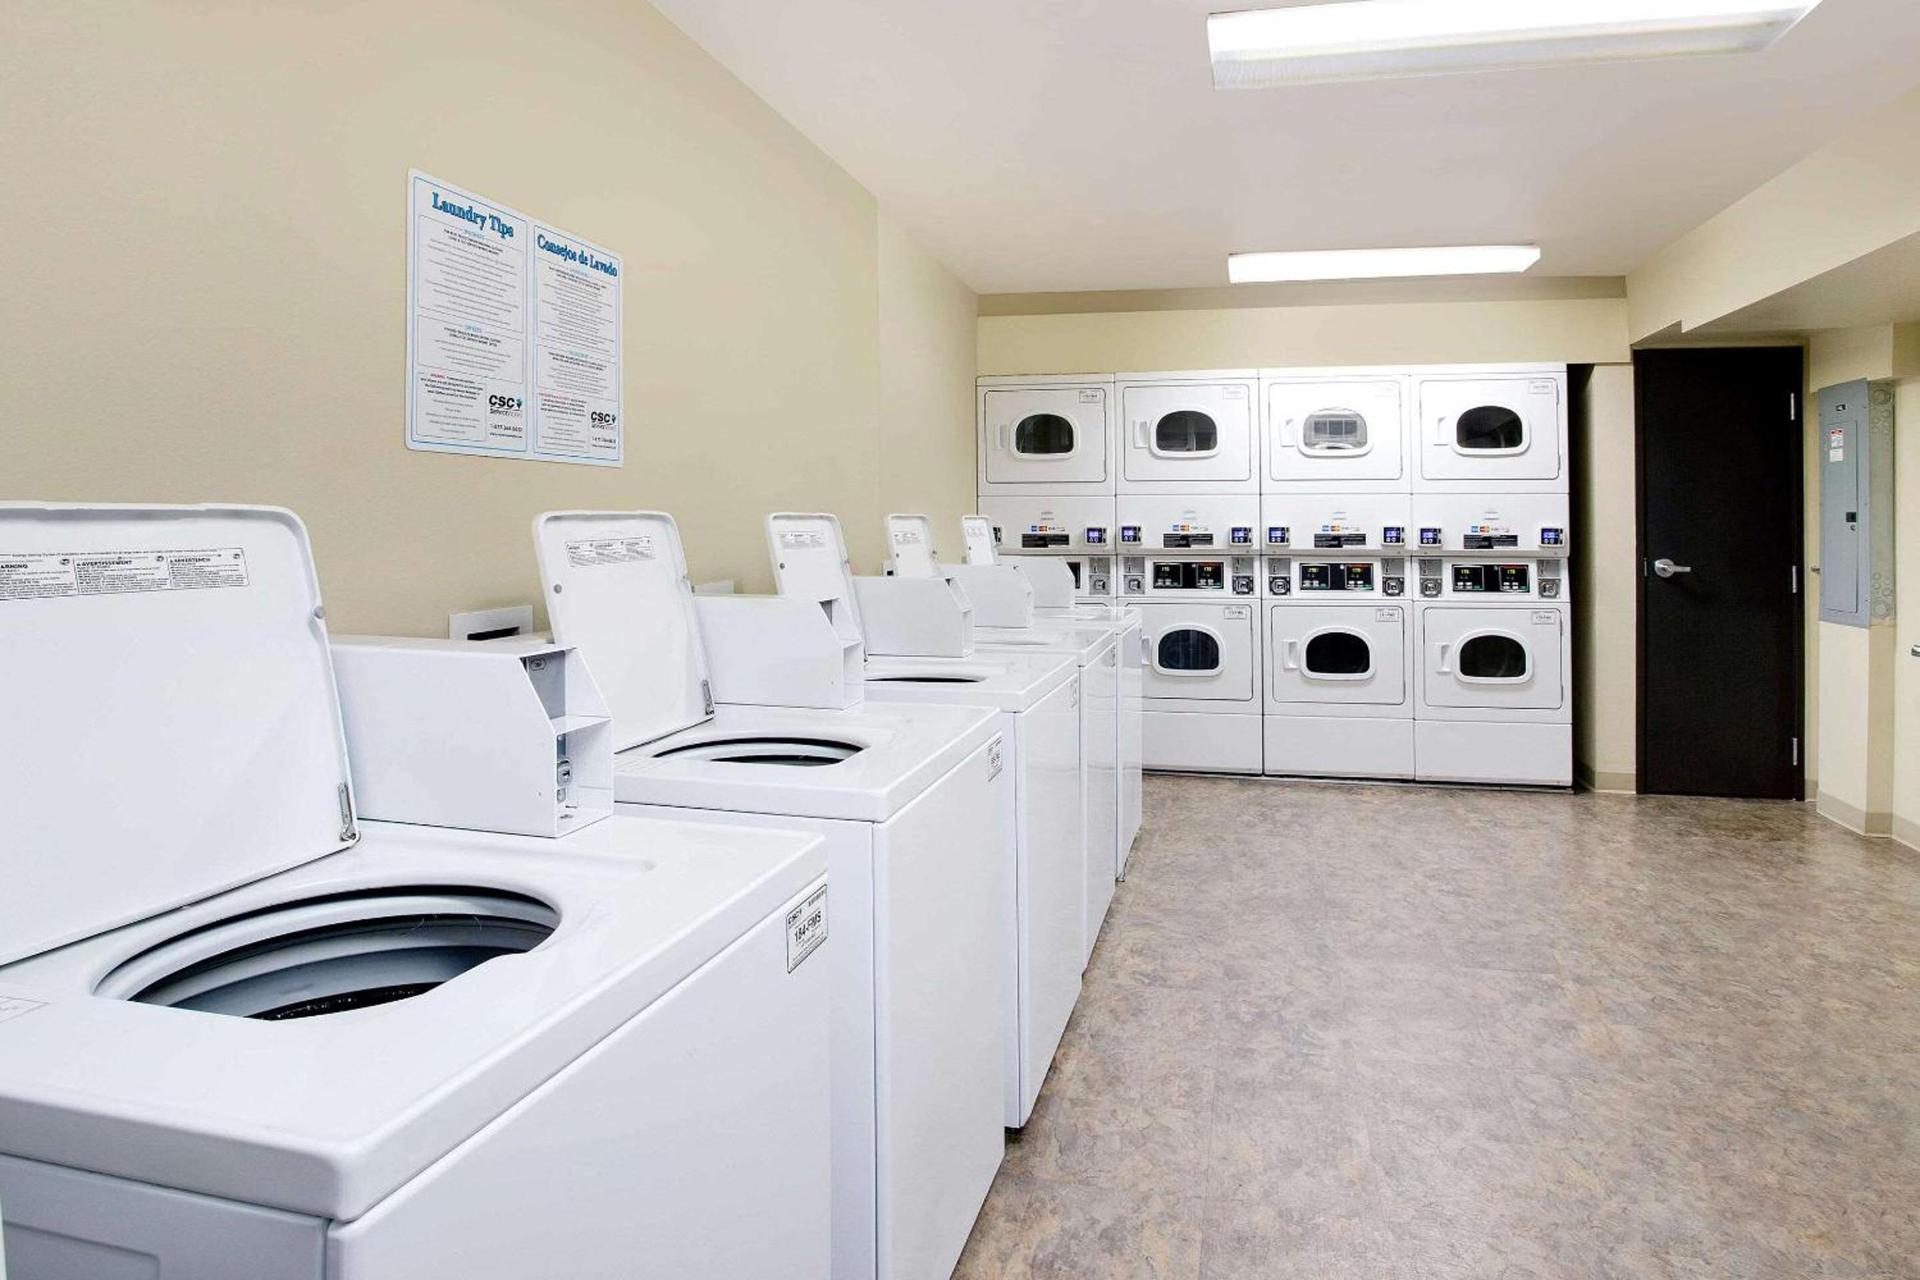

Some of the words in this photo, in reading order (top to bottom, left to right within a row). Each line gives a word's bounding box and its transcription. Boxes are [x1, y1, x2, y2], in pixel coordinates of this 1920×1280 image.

[432, 192, 487, 230] Laundry
[489, 213, 514, 239] Tips
[537, 234, 577, 262] Consejos
[578, 249, 588, 266] de
[590, 254, 618, 277] Lavado
[489, 394, 515, 408] CSC
[591, 411, 611, 423] CSC
